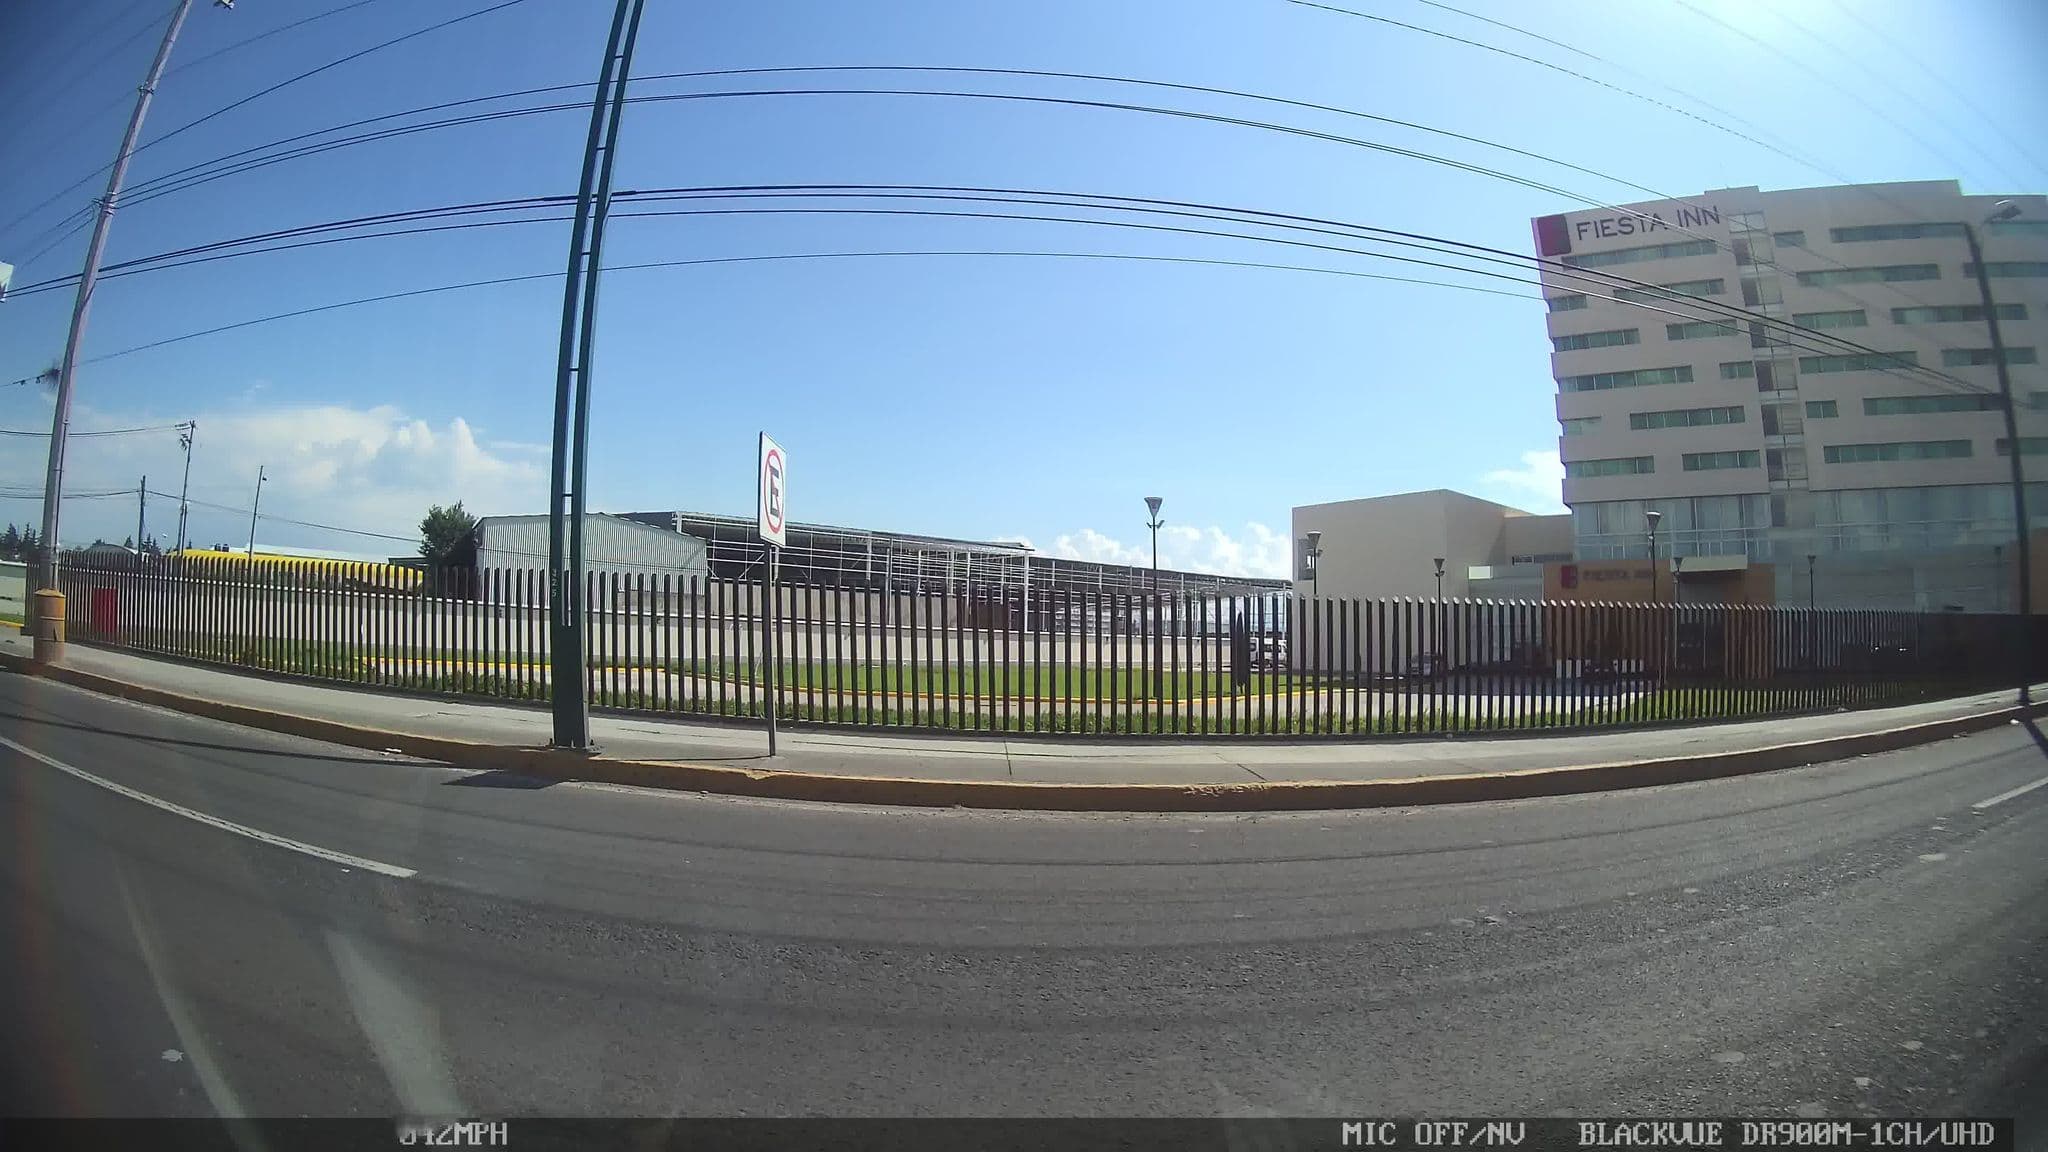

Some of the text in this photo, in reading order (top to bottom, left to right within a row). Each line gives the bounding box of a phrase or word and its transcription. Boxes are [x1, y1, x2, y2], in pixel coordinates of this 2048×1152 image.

[1576, 205, 1721, 241] FIESTA INN
[769, 464, 780, 518] E
